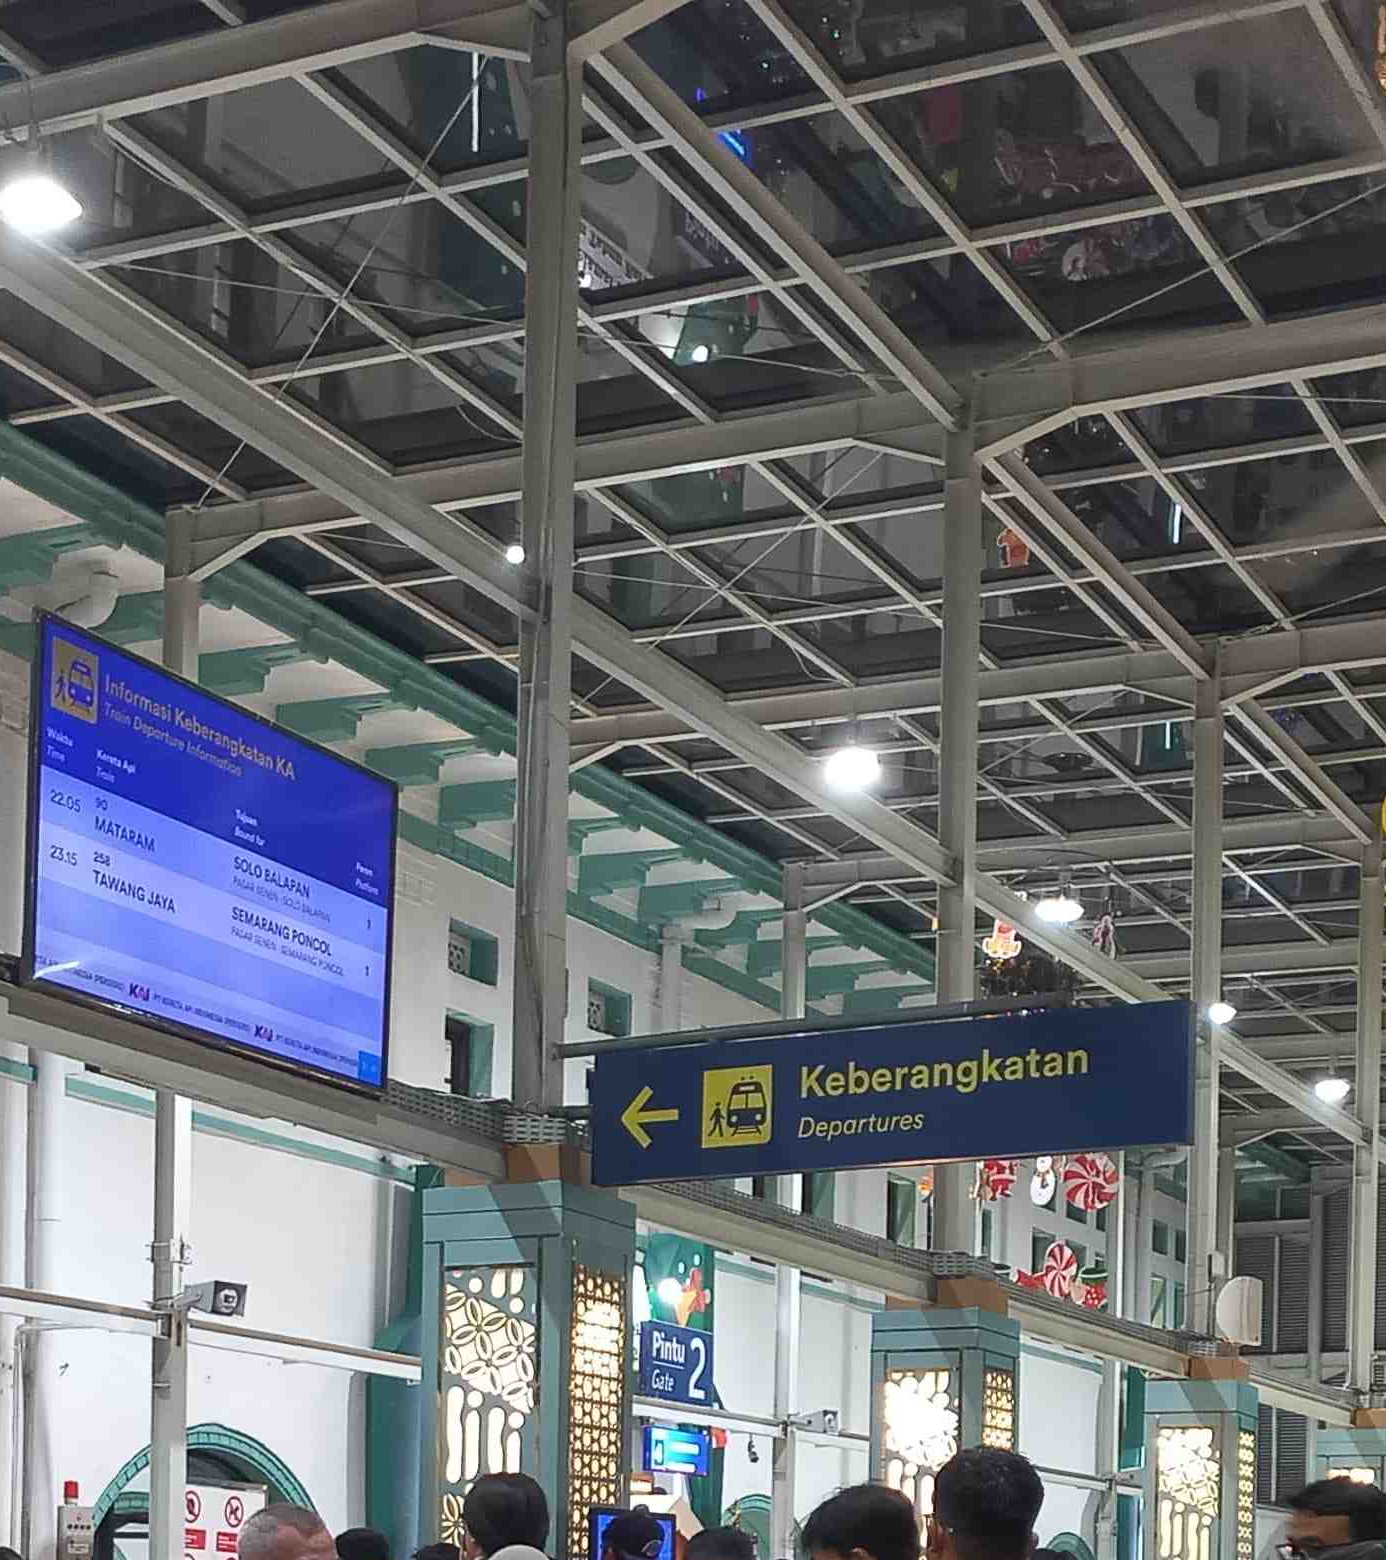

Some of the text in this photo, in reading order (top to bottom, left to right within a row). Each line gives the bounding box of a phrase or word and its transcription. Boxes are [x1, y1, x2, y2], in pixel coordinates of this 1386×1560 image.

[104, 702, 243, 776] Train Departure Information
[105, 674, 295, 780] Informasi Keberangkatan KA
[50, 789, 81, 813] 22.05
[50, 844, 78, 867] 23.15
[94, 816, 156, 853] MATARAM
[93, 869, 176, 914] TAWANG JAYA
[233, 856, 310, 899] SOLO BALAPAN
[231, 906, 333, 957] SEMARANG PONCOL
[800, 1048, 1089, 1099] Keberangkatan
[797, 1111, 925, 1141] Departures
[651, 1368, 674, 1392] Gate
[652, 1330, 706, 1400] Pintu 2
